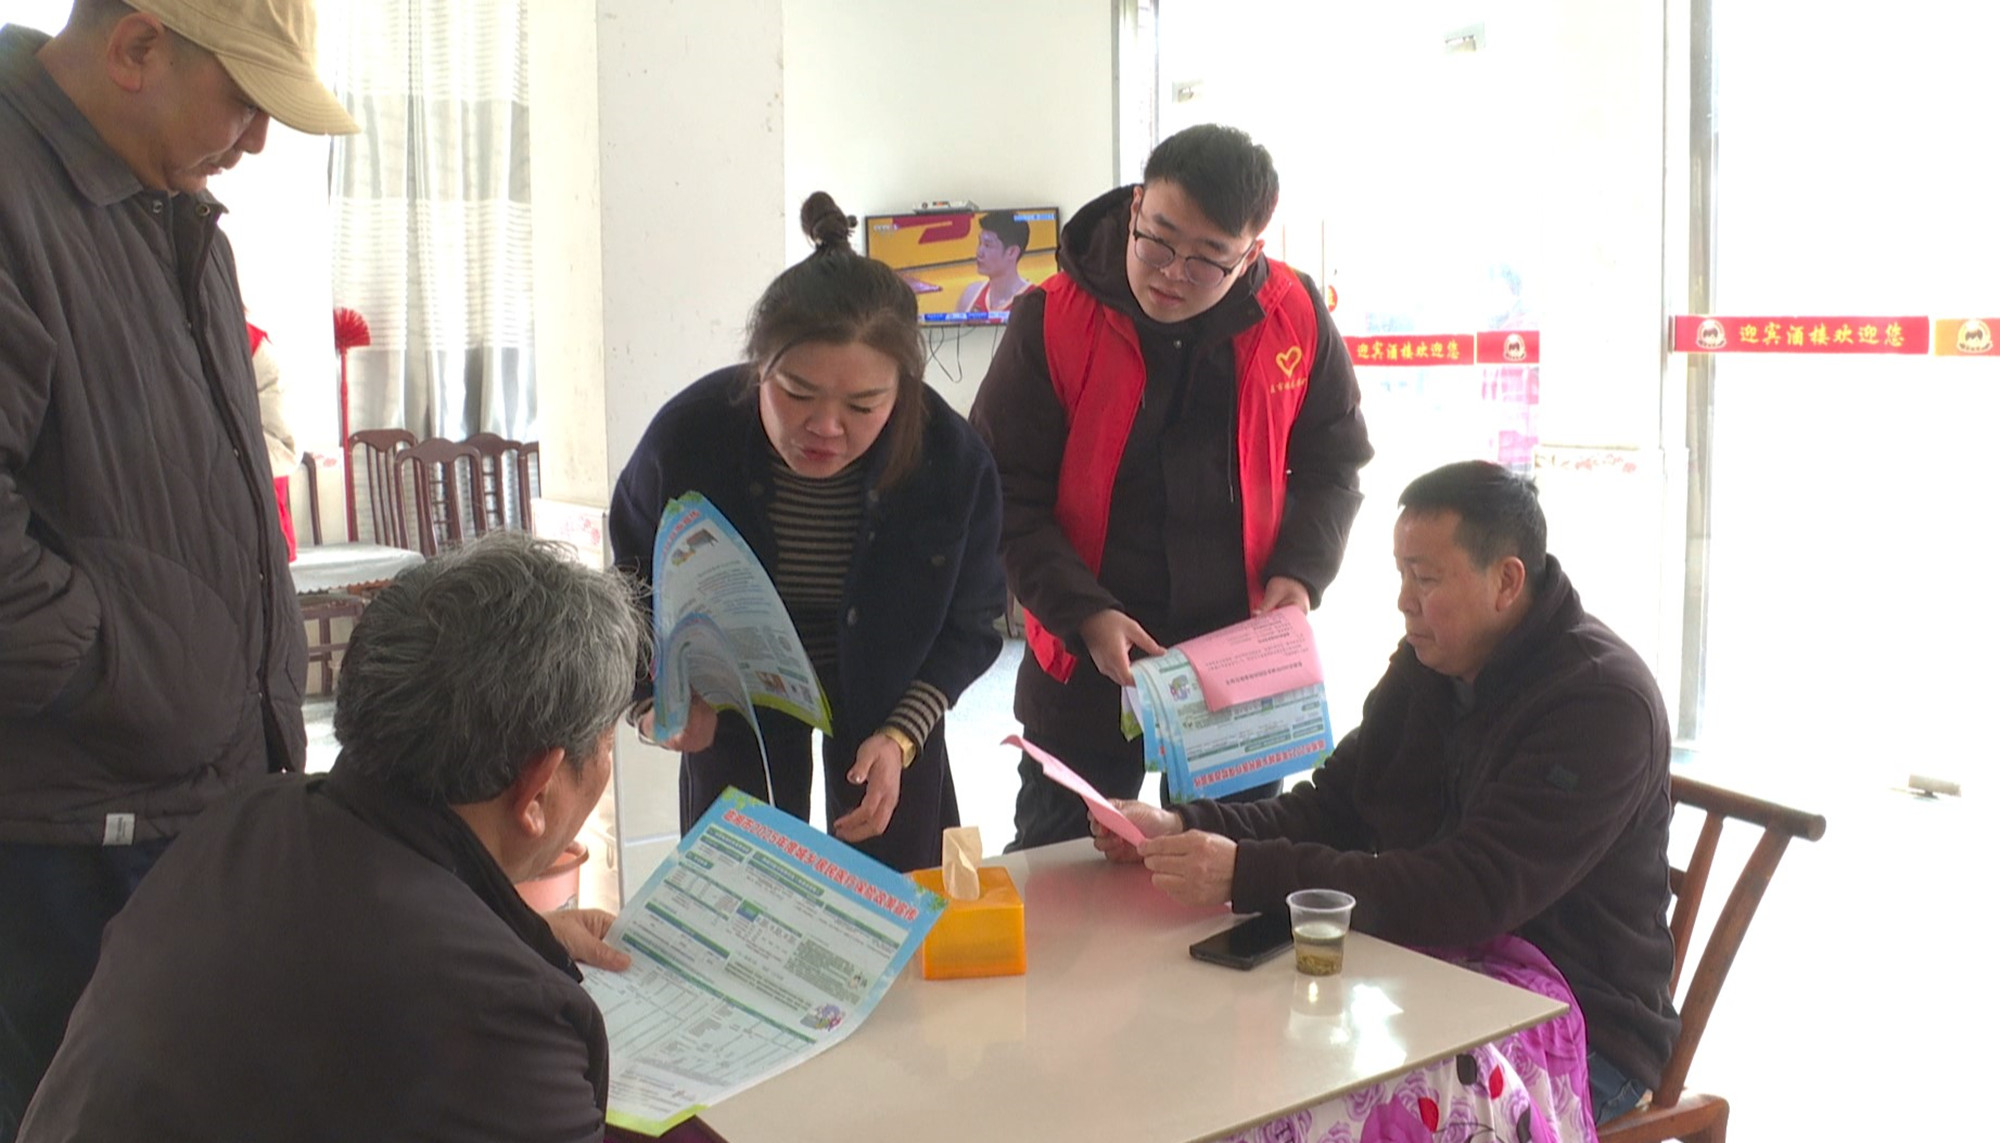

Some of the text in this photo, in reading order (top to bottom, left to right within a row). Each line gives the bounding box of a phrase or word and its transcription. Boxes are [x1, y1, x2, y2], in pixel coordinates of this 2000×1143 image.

[1739, 321, 1905, 348] 迎宾酒楼欢迎您
[1356, 339, 1461, 361] 迎宾酒楼欢迎您
